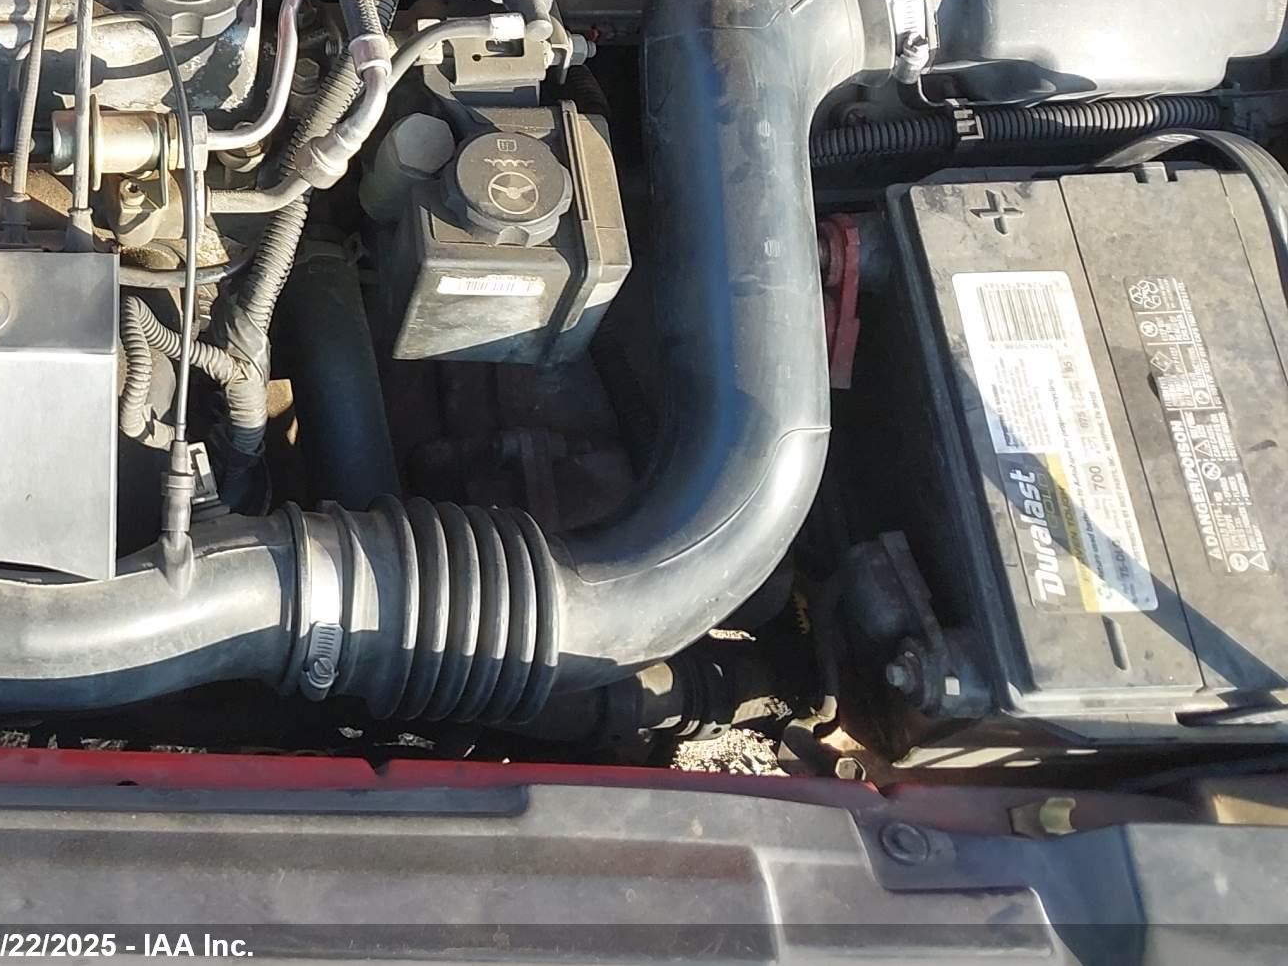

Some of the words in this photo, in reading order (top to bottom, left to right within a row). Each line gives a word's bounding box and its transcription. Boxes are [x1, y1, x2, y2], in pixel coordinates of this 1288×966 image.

[1035, 473, 1059, 528] GOLD
[1087, 465, 1107, 490] 700
[1169, 419, 1218, 547] DANGER/POISON
[1007, 468, 1067, 601] Duralast
